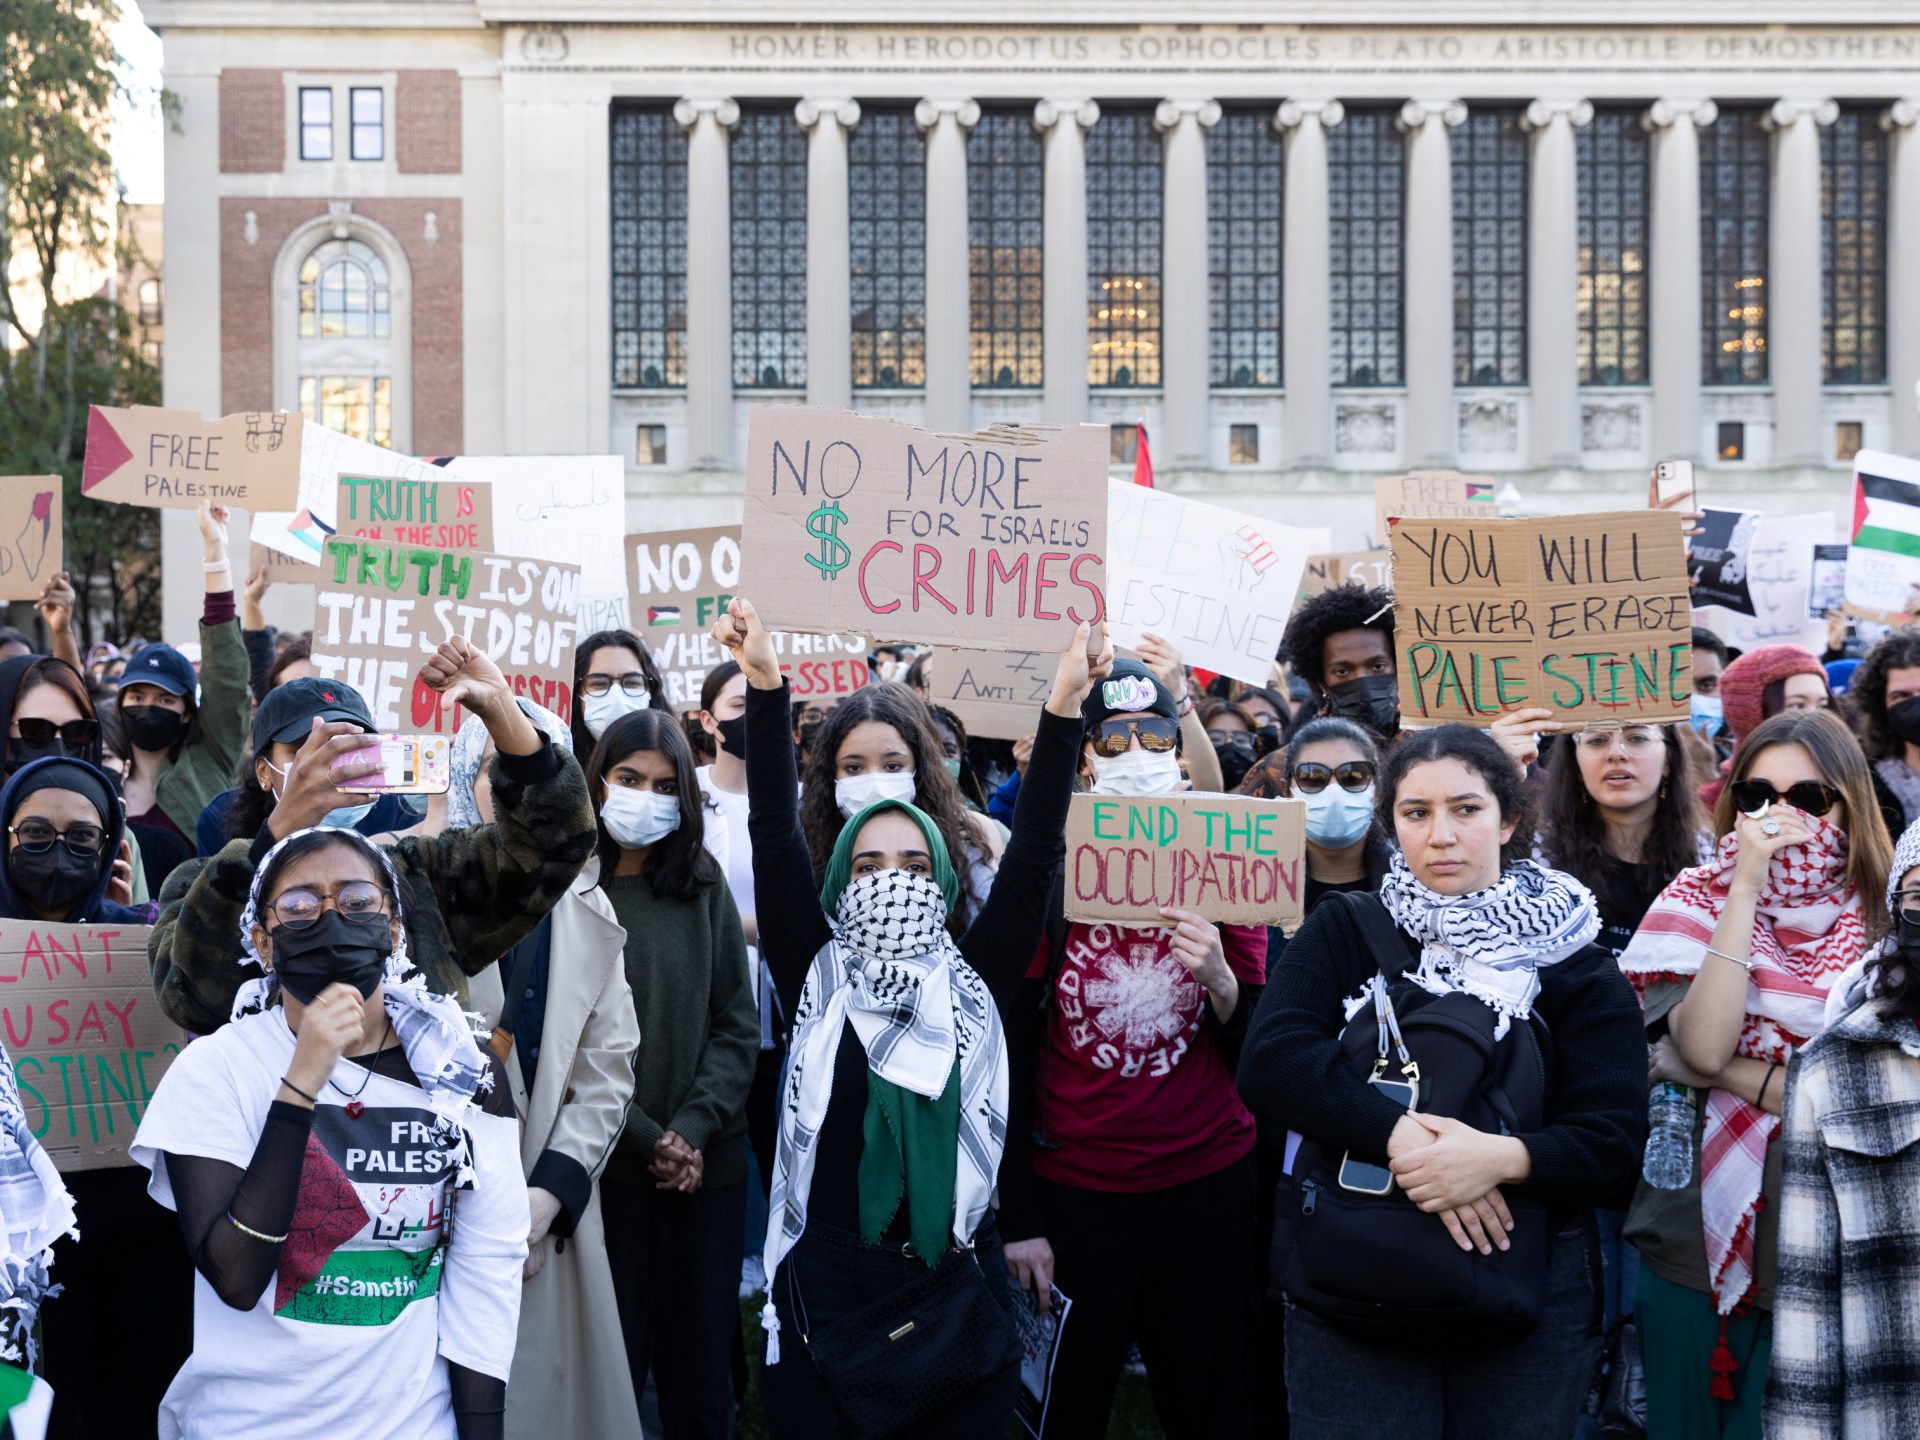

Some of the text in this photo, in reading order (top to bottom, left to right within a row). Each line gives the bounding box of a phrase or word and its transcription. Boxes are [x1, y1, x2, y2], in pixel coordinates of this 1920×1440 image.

[730, 35, 1916, 60] HOMER HERODOTUS SOPHOCLES PLATO ARISTOTLE DEMOSTHEN
[149, 433, 223, 471] FREE
[771, 439, 1043, 510] NO MORE
[145, 474, 248, 498] PALESTINE
[340, 477, 475, 523] TRUTH IS
[1402, 477, 1459, 504] FREE
[887, 510, 1090, 548] FOR ISRAEL'S
[327, 541, 583, 617] TRUTH IS ON
[636, 542, 703, 595] NO
[858, 540, 1105, 627] CRIMES
[1401, 528, 1661, 587] YOU WILL
[317, 592, 415, 649] THE
[1415, 600, 1535, 638] NEVER
[1546, 596, 1690, 640] ERASE
[310, 653, 409, 730] THE
[1093, 802, 1278, 855] END THE
[1075, 843, 1298, 907] OCCUPATION
[47, 998, 137, 1049] SAY
[391, 1121, 440, 1145] FR
